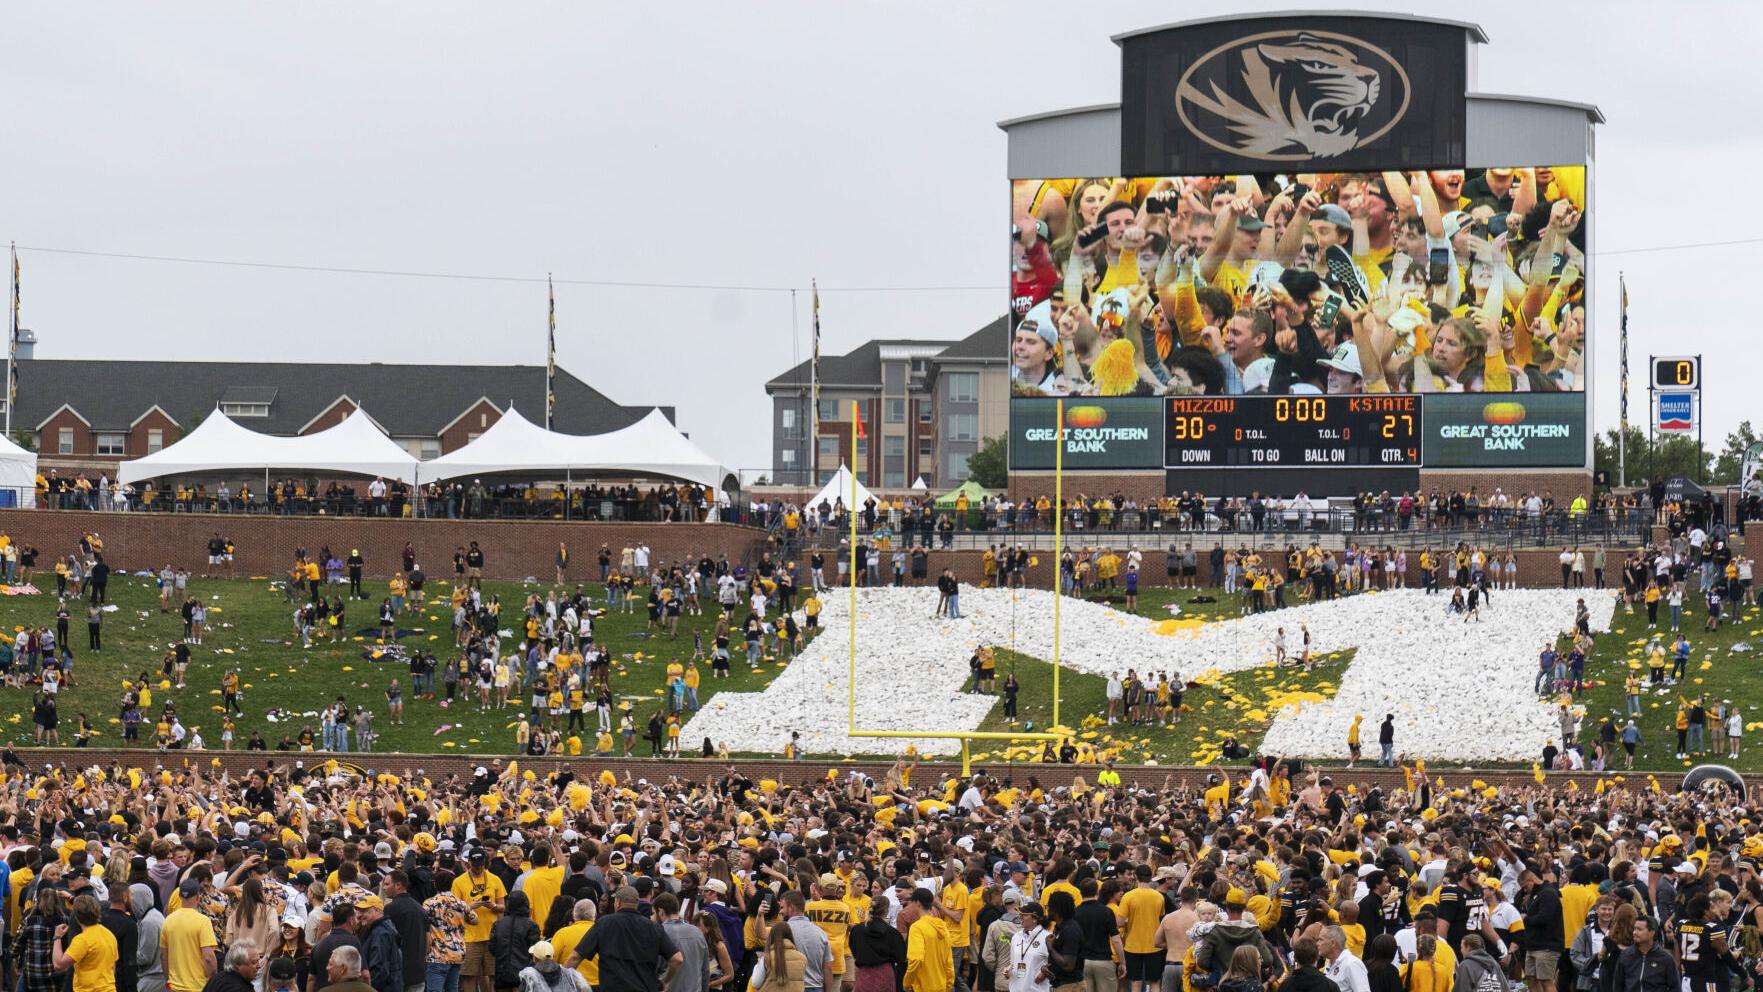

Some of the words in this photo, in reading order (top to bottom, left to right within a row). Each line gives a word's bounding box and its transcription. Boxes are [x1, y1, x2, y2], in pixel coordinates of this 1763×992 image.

[1677, 361, 1690, 385] 0
[1173, 400, 1235, 413] MIZZOU
[1276, 399, 1326, 421] 0:00
[1350, 398, 1416, 412] KSTATE
[1175, 417, 1203, 439] 30
[1383, 415, 1413, 438] 27
[1440, 425, 1488, 438] GREAT
[1491, 424, 1570, 437] SOUTHERN
[1074, 427, 1148, 440] SOUTHERN
[1246, 429, 1267, 439] T.O.L.
[1318, 429, 1340, 439] T.O.L.
[1067, 440, 1106, 453] BANK
[1484, 438, 1525, 450] BANK
[1182, 449, 1211, 462] DOWN
[1252, 449, 1264, 462] TO
[1266, 449, 1280, 462] GO
[1305, 449, 1330, 462] BALL
[1331, 449, 1345, 462] ON
[1381, 449, 1404, 463] QTR.
[1407, 448, 1417, 462] 4
[1681, 933, 1700, 960] 12
